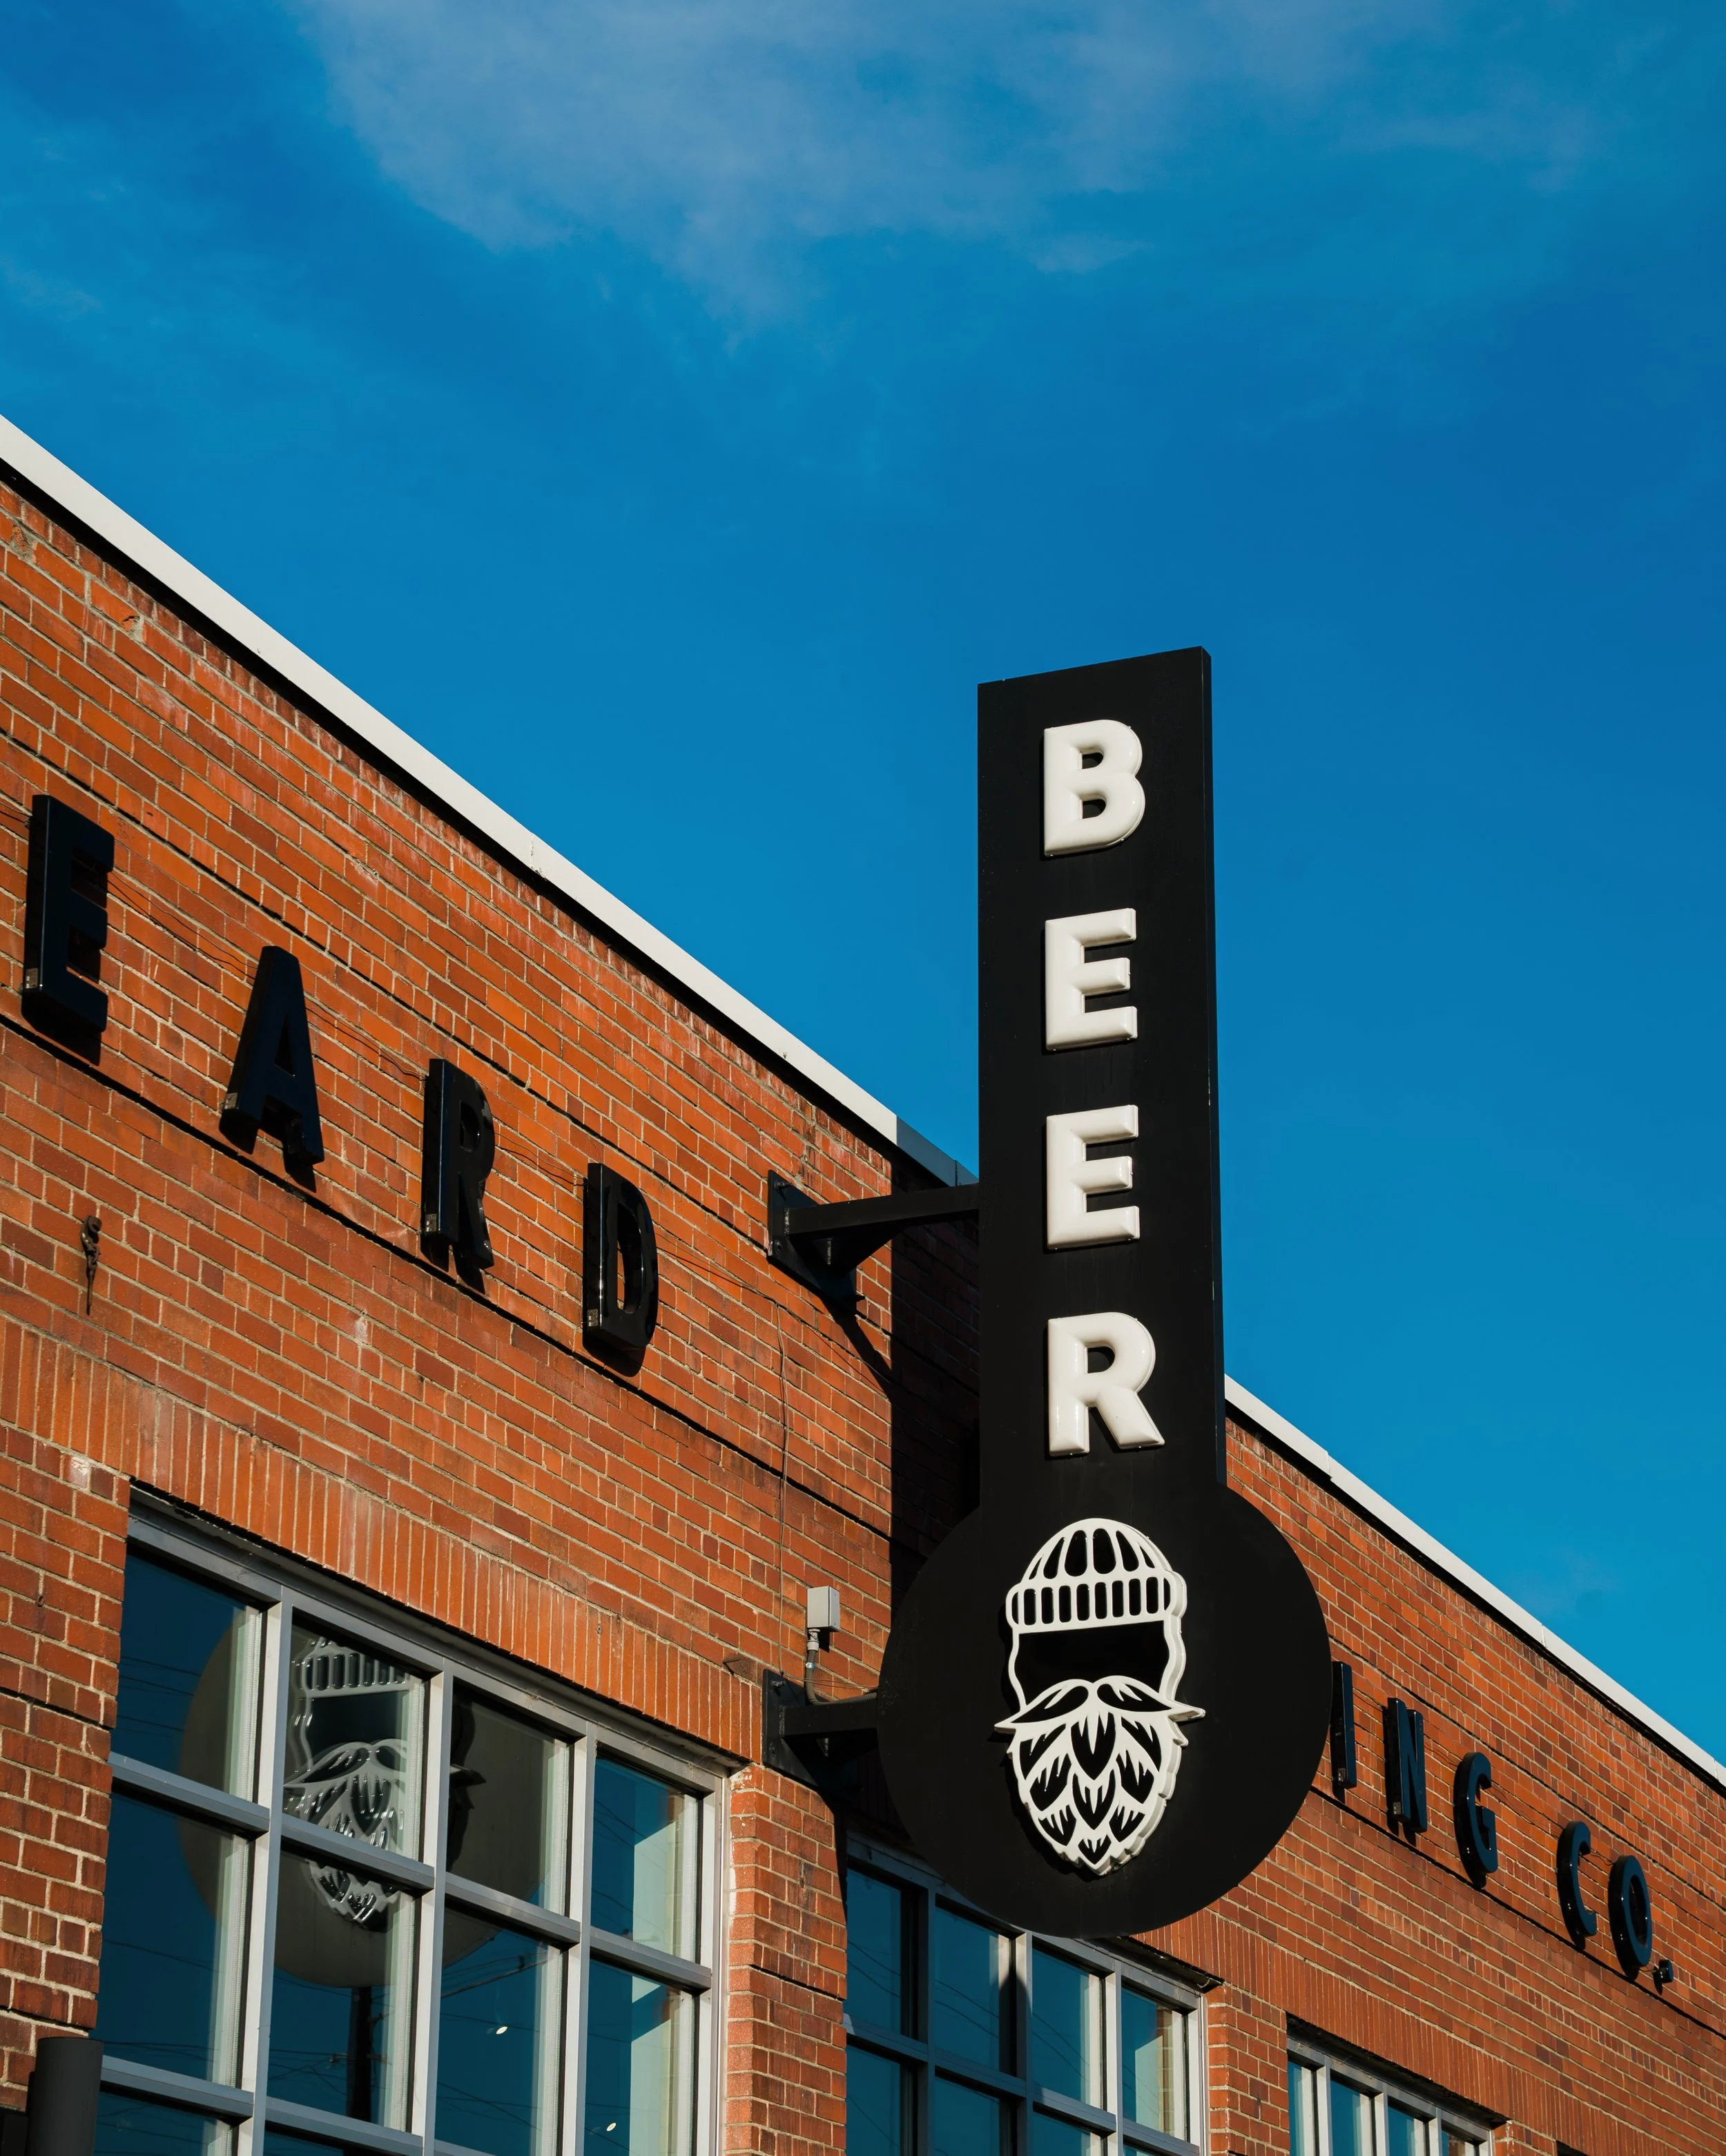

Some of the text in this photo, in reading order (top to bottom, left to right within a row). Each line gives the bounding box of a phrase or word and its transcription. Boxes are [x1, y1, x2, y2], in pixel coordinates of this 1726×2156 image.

[22, 795, 659, 1351] EARD
[1043, 718, 1165, 1456] BEER
[1557, 1821, 1674, 1983] CO.
